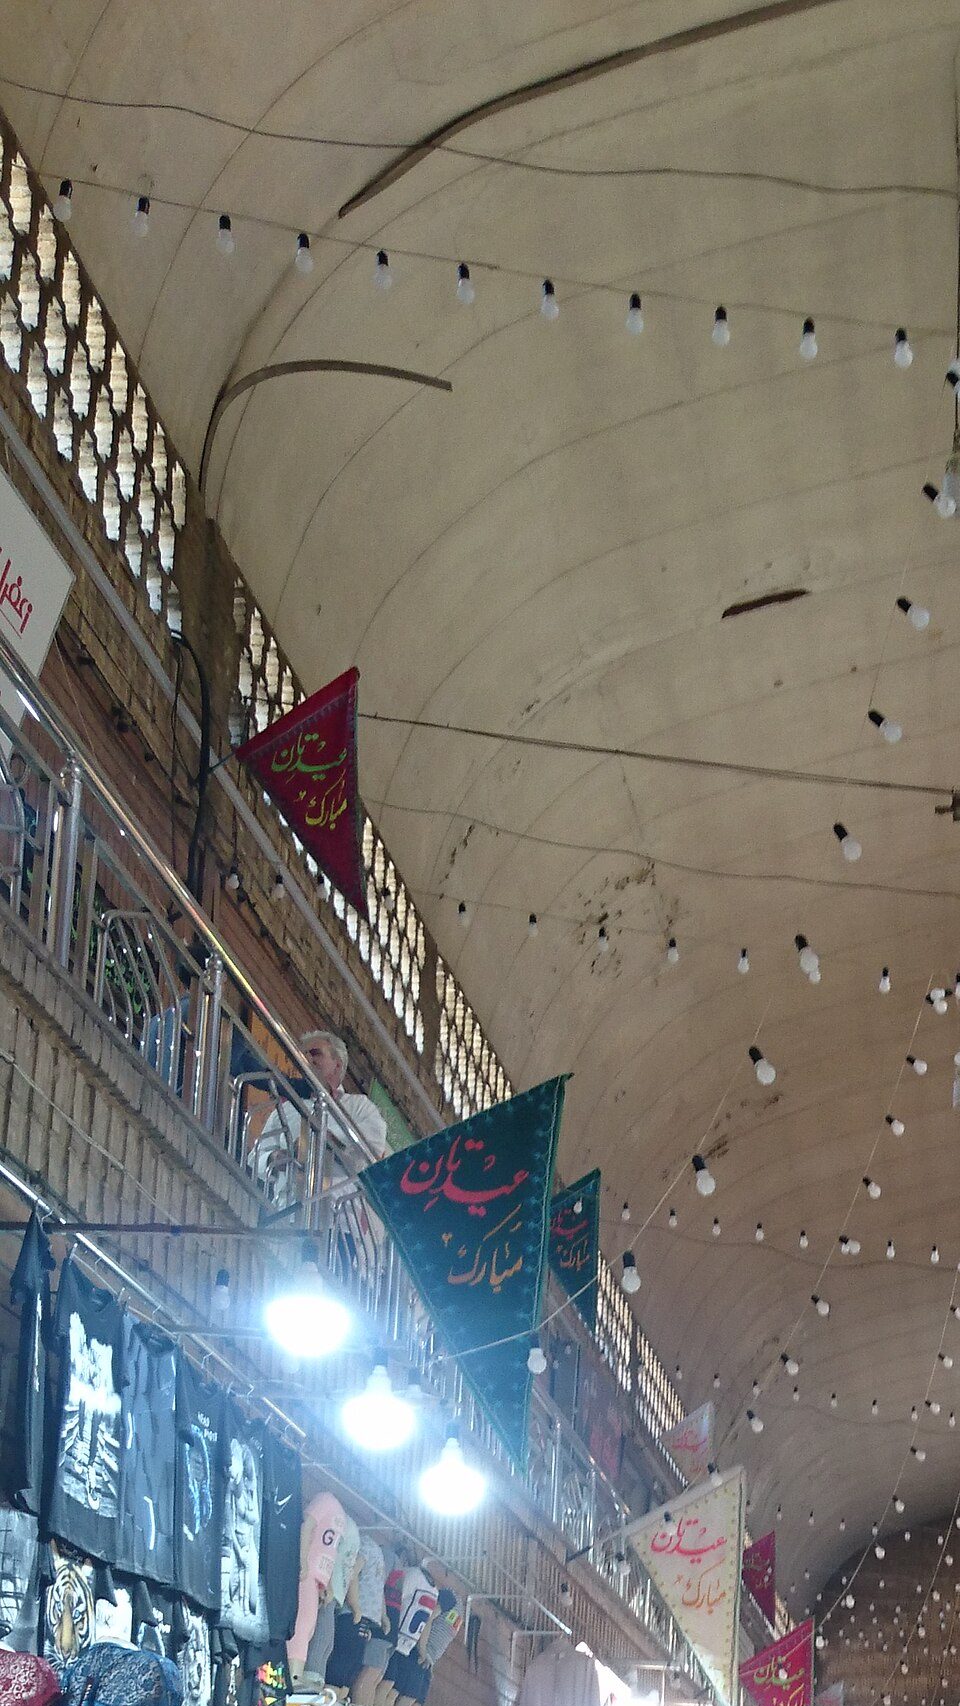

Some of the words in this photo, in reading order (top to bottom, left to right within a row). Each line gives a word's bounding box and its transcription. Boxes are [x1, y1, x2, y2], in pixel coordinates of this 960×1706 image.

[0, 546, 33, 634] زعفرا
[272, 732, 347, 782] عیدتان
[303, 769, 348, 830] مبارک
[400, 1136, 530, 1217] عیدتان
[446, 1203, 523, 1293] مبارک
[651, 1516, 727, 1563] عیدتان
[682, 1557, 726, 1616] مبارک
[754, 1653, 804, 1690] عیدتان
